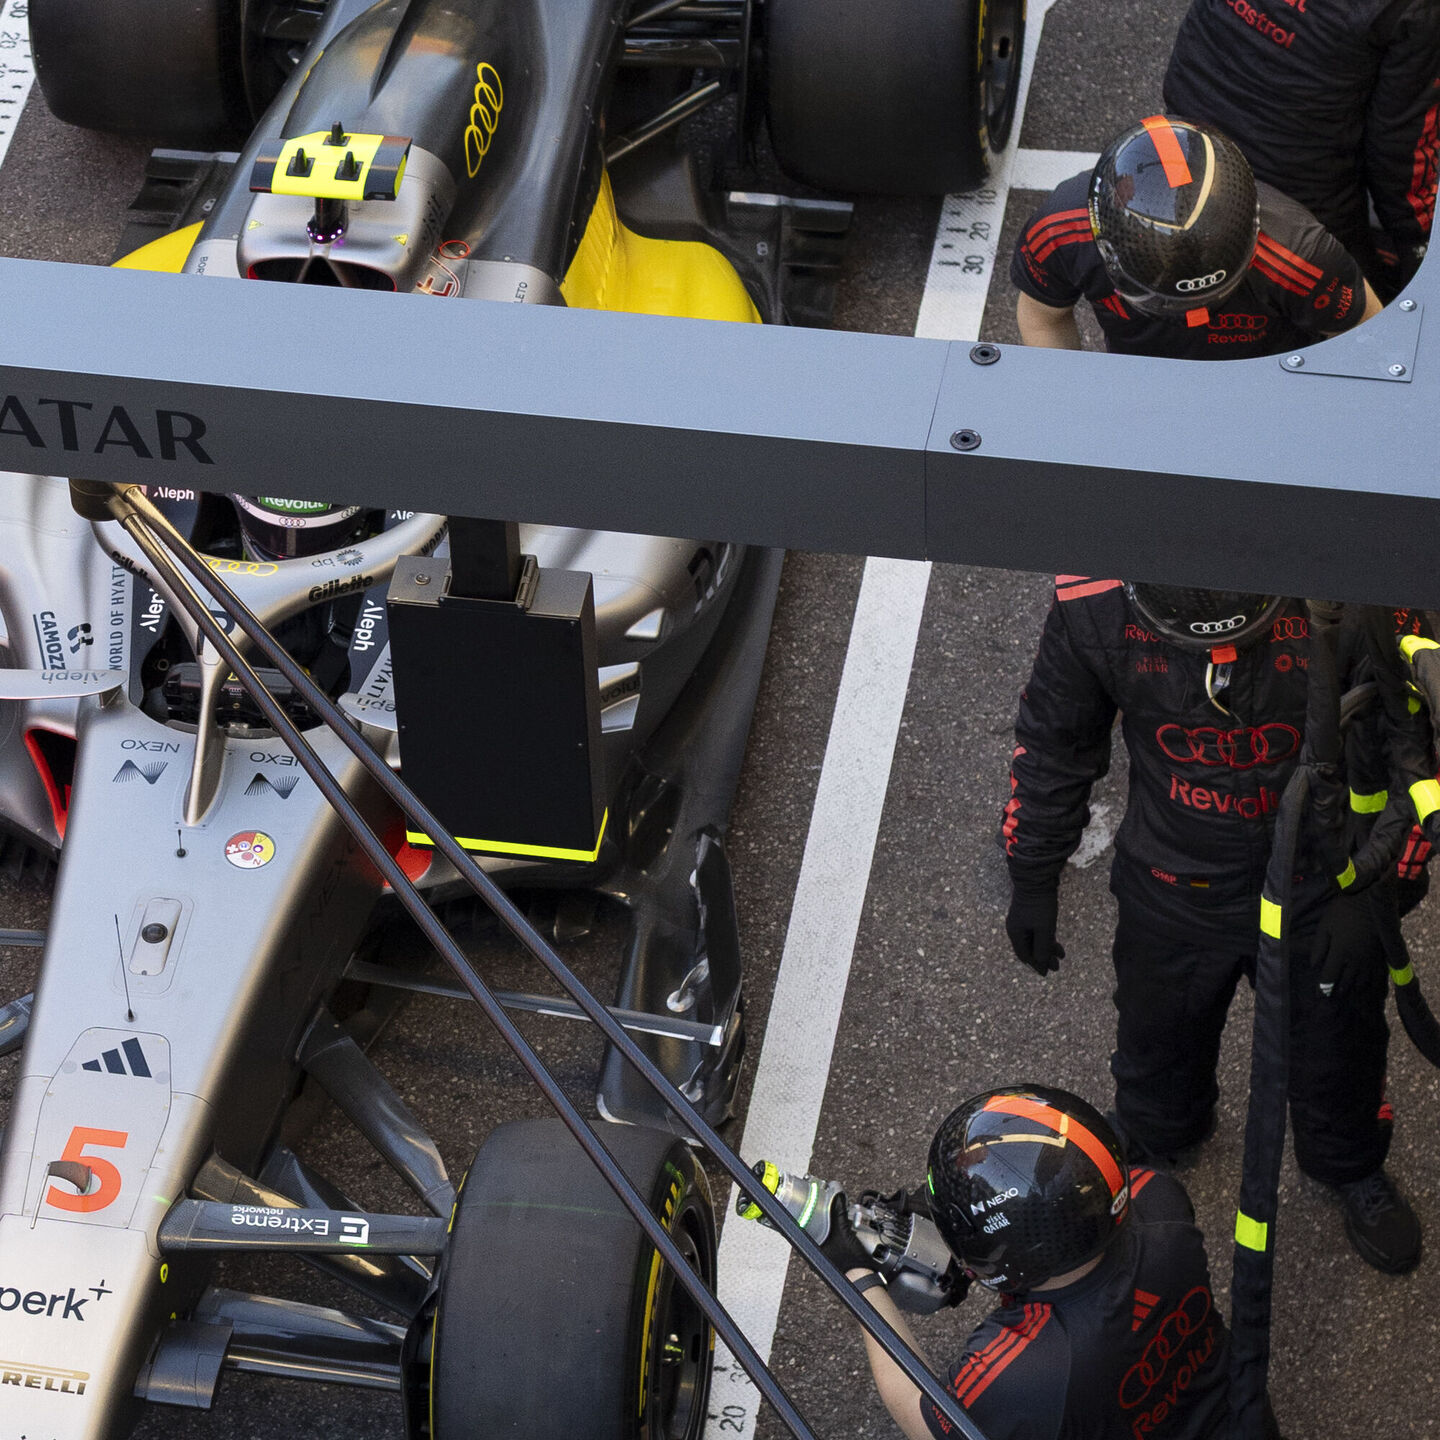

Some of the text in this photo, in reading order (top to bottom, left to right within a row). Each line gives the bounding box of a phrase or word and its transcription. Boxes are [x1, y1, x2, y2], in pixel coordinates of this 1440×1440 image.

[9, 1, 28, 19] 30
[0, 31, 20, 50] 20
[969, 221, 990, 241] 20
[962, 255, 984, 274] 30
[513, 281, 528, 303] LETO
[153, 486, 195, 502] Aleph
[111, 565, 126, 606] HYATT
[308, 572, 374, 602] Gillette
[353, 599, 385, 652] Aleph
[40, 610, 66, 670] CAMOZZ
[41, 671, 107, 683] Aleph
[120, 737, 181, 753] NEXO
[46, 1126, 128, 1212] 5
[986, 1187, 1019, 1208] NEXO
[232, 1205, 284, 1215] networks
[231, 1213, 330, 1237] Extreme
[720, 1405, 746, 1433] 20
